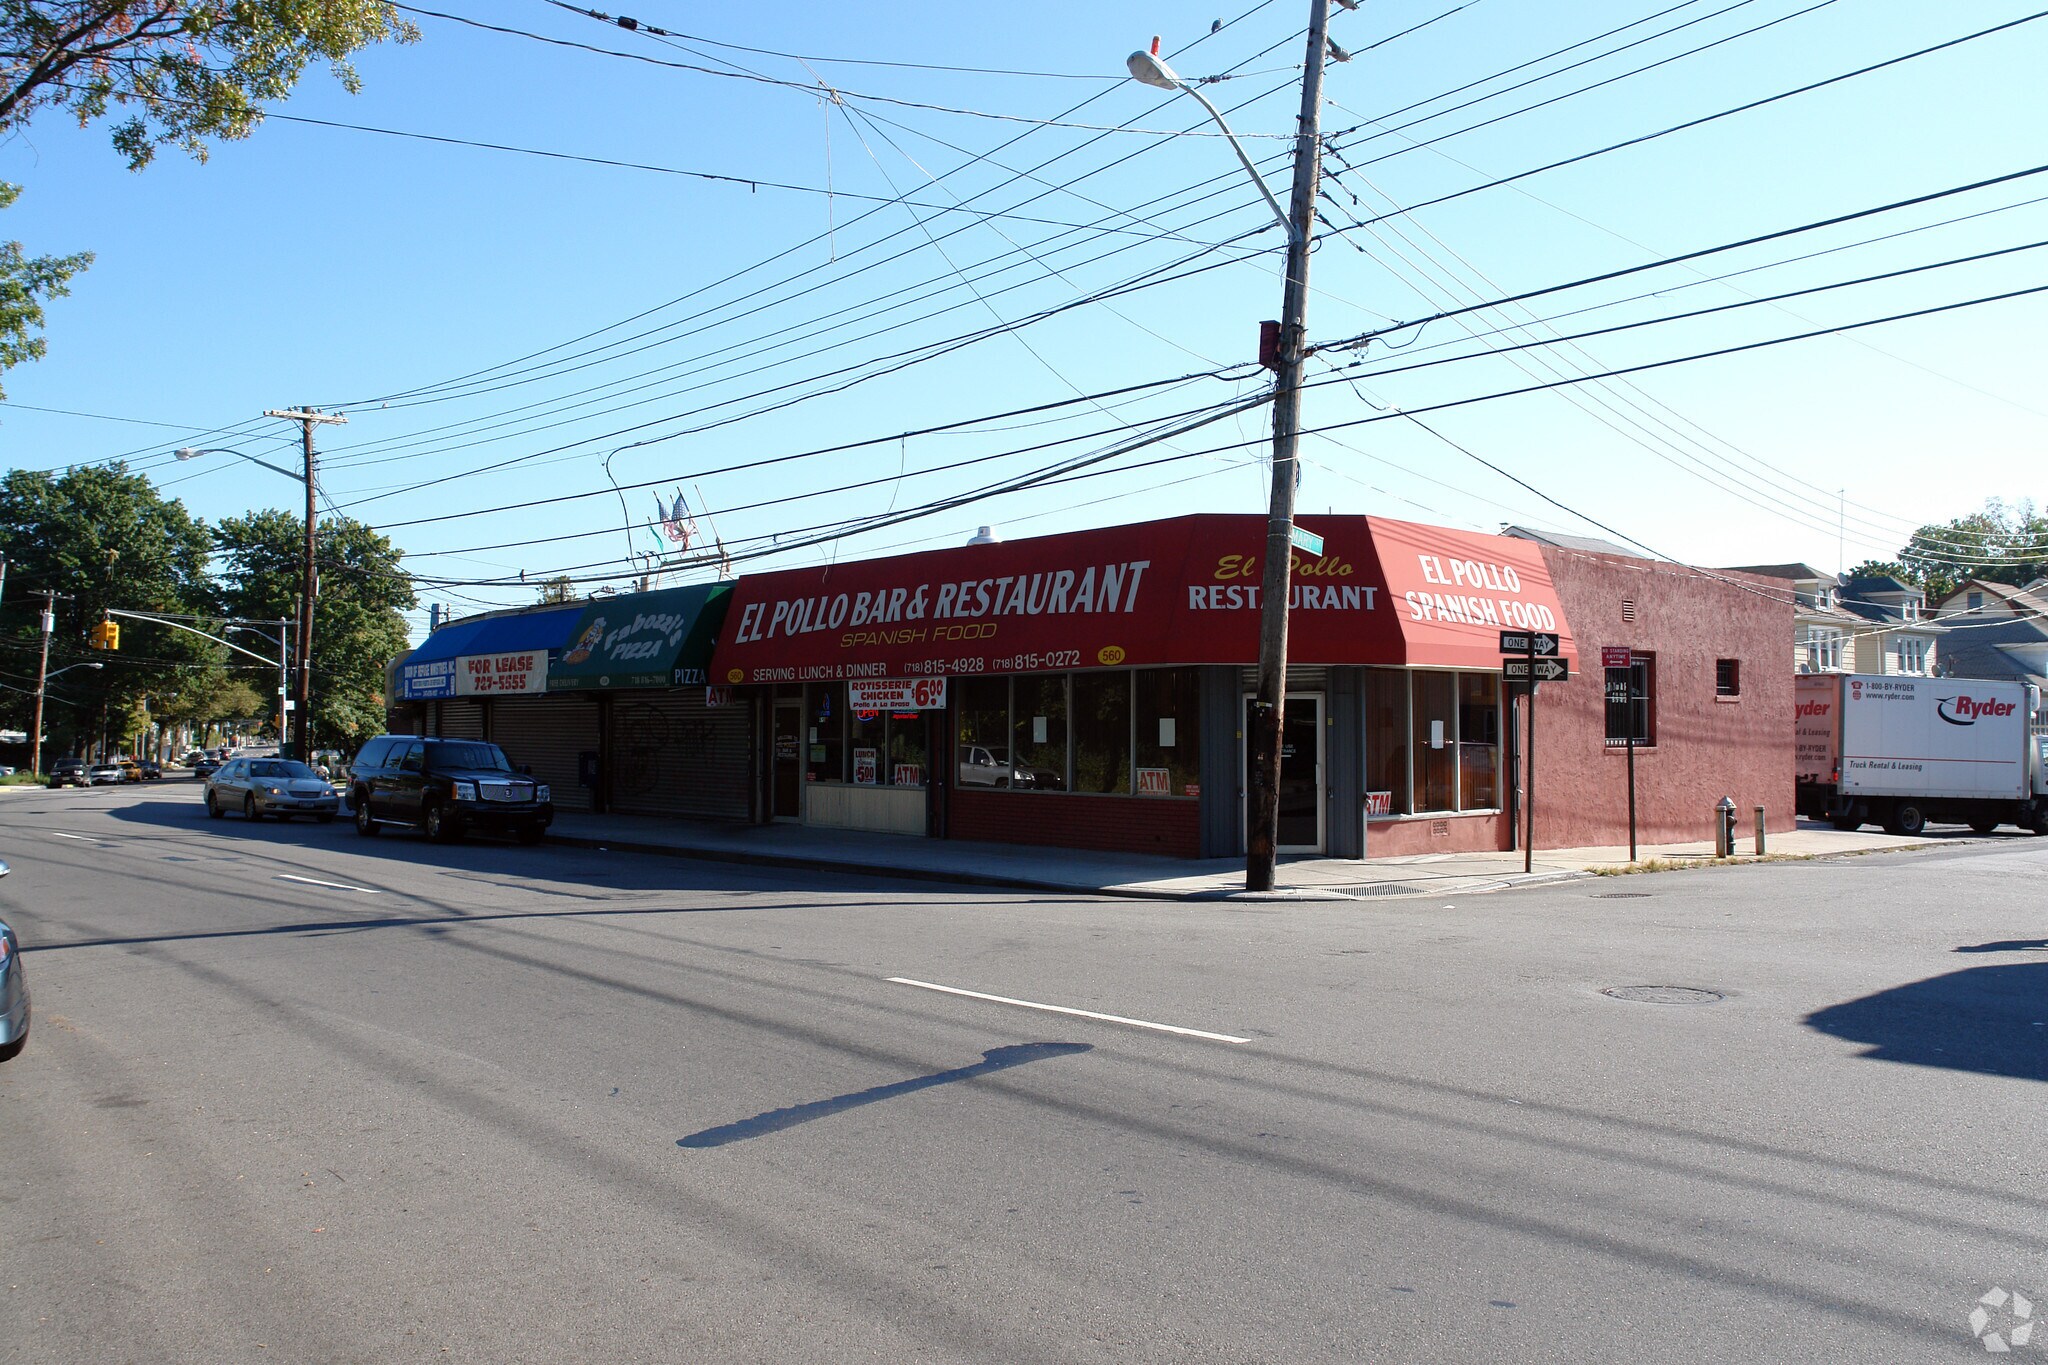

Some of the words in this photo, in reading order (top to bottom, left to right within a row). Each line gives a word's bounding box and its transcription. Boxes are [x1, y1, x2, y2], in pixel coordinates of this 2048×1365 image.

[1214, 555, 1256, 580] El
[1417, 554, 1452, 585] EL
[1448, 558, 1521, 594] POLLO
[735, 602, 766, 644] EL
[766, 593, 849, 639] POLLO
[849, 587, 907, 627] BAR
[933, 560, 1151, 619] RESTAURANT
[1188, 585, 1378, 610] RESTURANT
[1405, 590, 1501, 626] SPANISH
[1498, 600, 1556, 631] FOOD
[840, 628, 927, 648] SPANISH
[932, 623, 997, 641] FOOD
[1508, 638, 1525, 647] ONE
[1533, 639, 1549, 649] WAY
[610, 640, 664, 660] PIZZA
[1102, 650, 1121, 662] 560
[468, 659, 492, 674] FOR
[495, 655, 534, 673] LEASE
[753, 667, 795, 681] SERVING
[798, 665, 833, 679] LUNCH
[836, 666, 843, 678] &
[846, 662, 887, 677] DINNER
[1511, 664, 1529, 674] ONE
[1537, 665, 1557, 674] WAY
[474, 674, 526, 691] 727-5555
[674, 668, 707, 685] PIZZA
[730, 671, 742, 681] 560
[851, 680, 912, 691] ROTISSERIE
[1865, 681, 1915, 692] 1-800-BY-RYDER
[708, 688, 736, 704] ATM
[860, 691, 904, 700] CHICKEN
[1865, 692, 1915, 701] www.ryder.com
[1795, 700, 1830, 720] yder
[1955, 696, 2016, 719] Ryder
[1808, 729, 1831, 738] Leasing
[855, 750, 875, 758] LUNCH
[1849, 760, 1867, 769] Truck
[1868, 761, 1890, 769] Rental
[1898, 762, 1922, 771] Leasing
[896, 766, 918, 784] ATM
[1139, 771, 1169, 790] ATM
